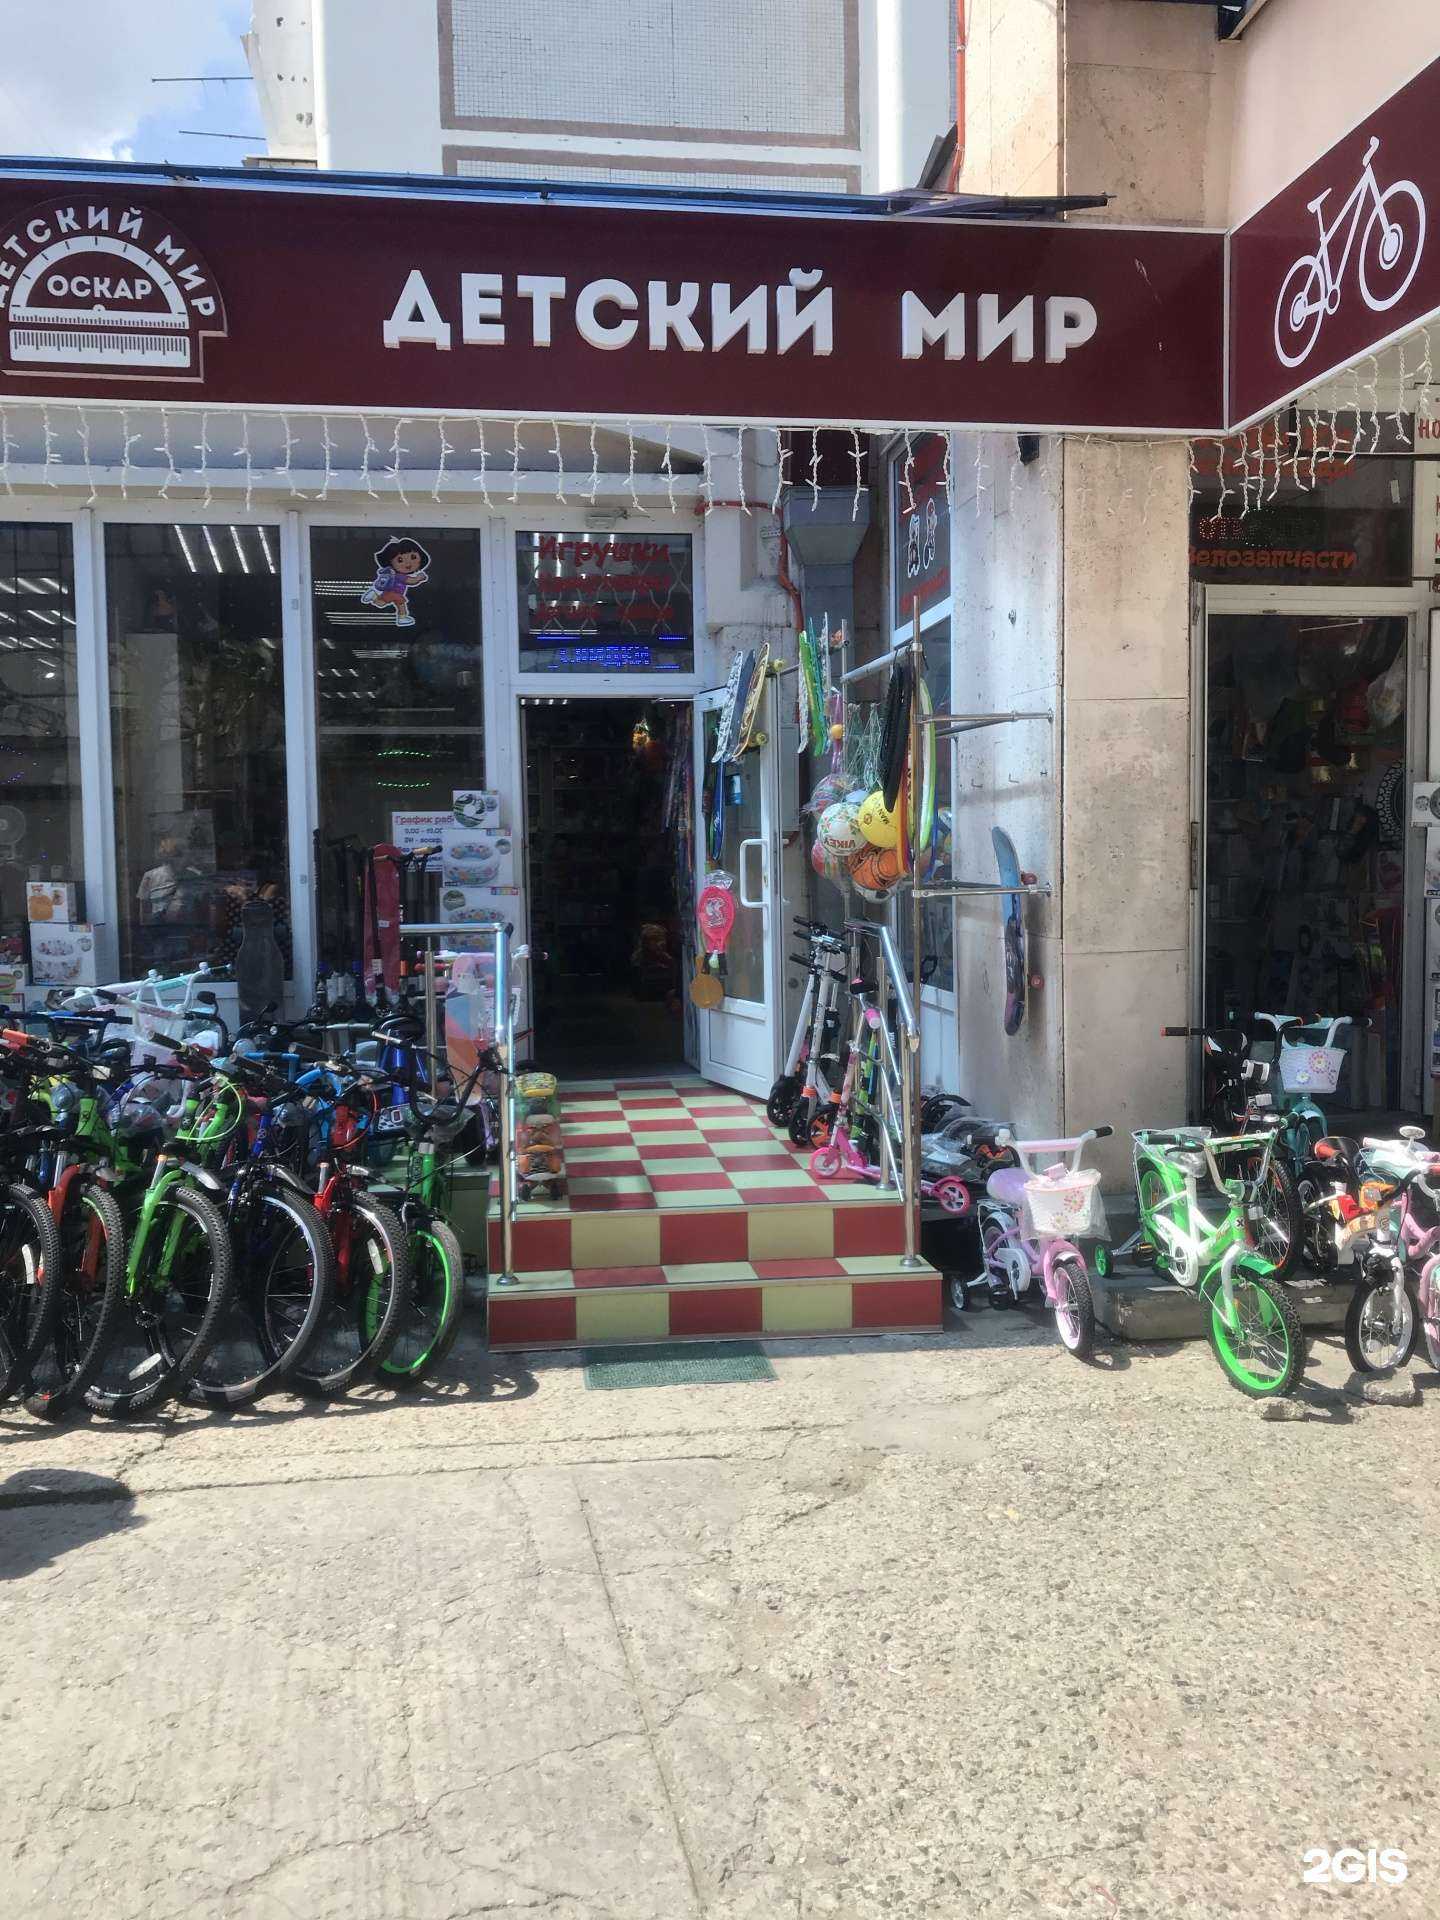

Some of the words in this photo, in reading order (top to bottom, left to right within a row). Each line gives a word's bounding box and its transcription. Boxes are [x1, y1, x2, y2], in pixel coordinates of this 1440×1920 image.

[47, 274, 152, 300] ОСКАР
[154, 234, 216, 316] МИР
[383, 268, 833, 357] ДЕТСКИЙ
[902, 290, 1098, 363] МИР
